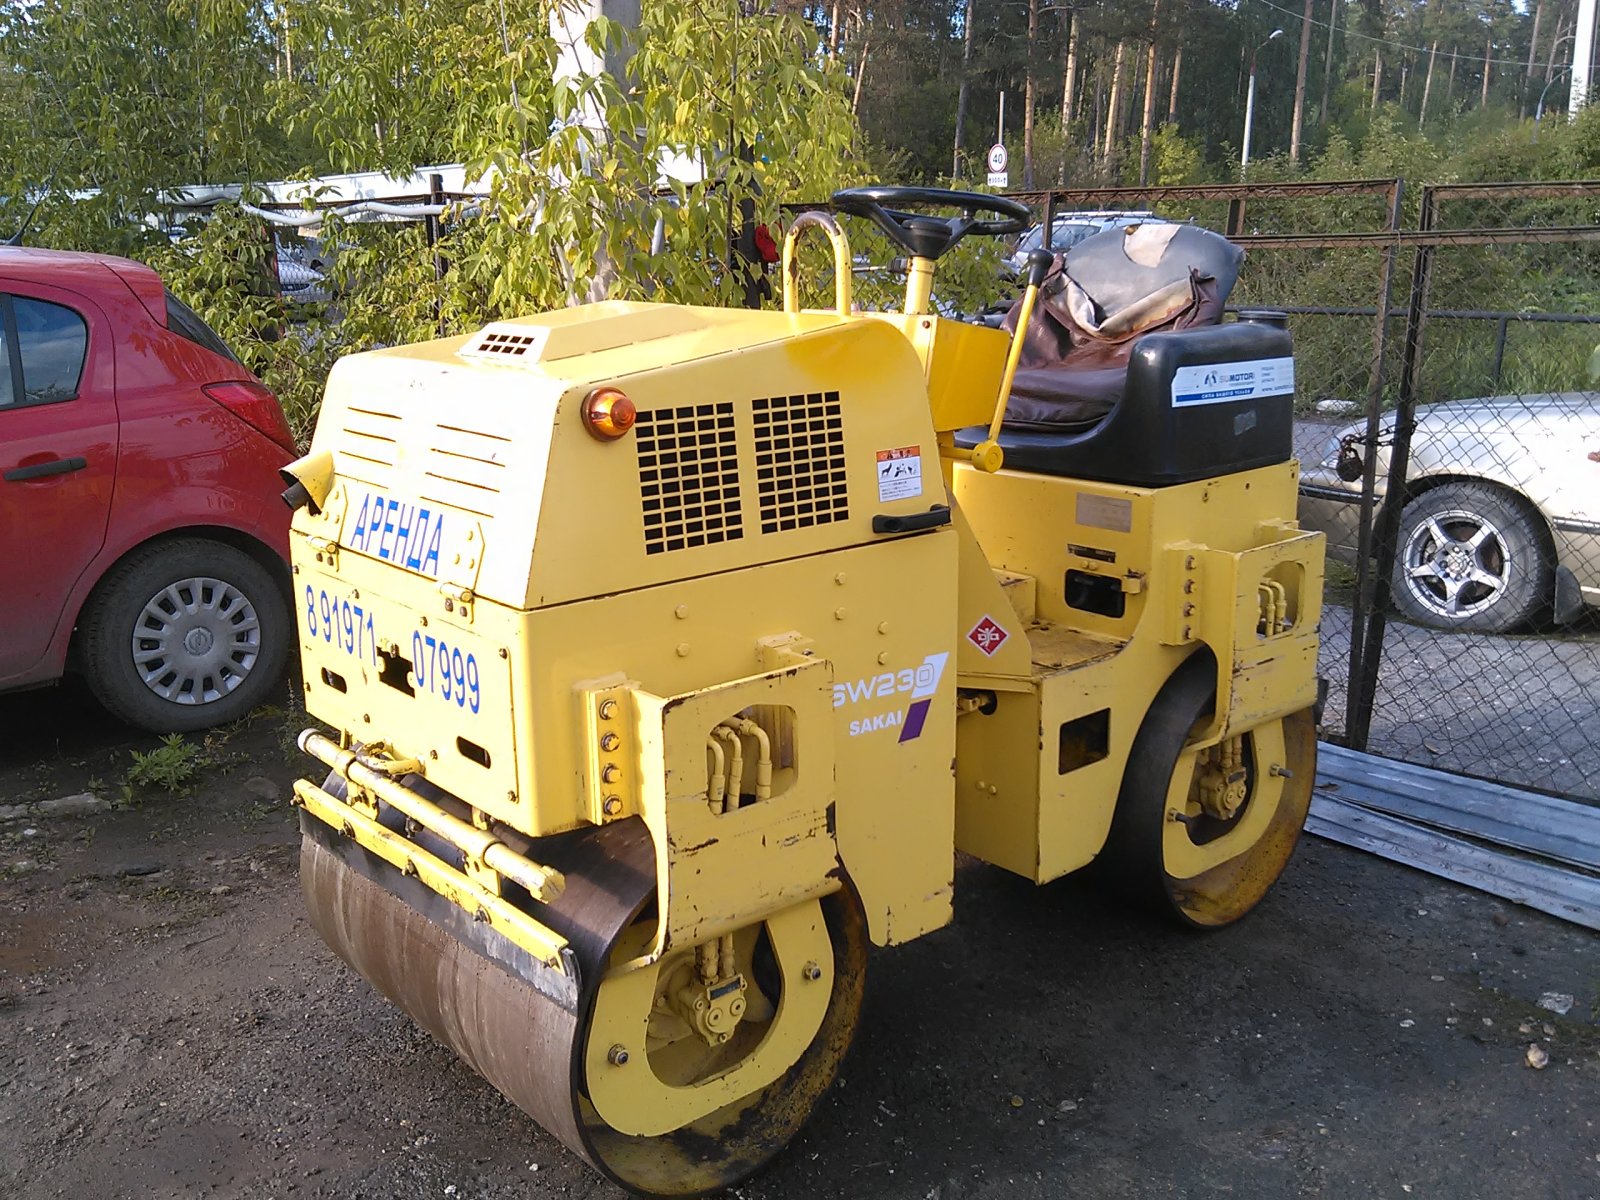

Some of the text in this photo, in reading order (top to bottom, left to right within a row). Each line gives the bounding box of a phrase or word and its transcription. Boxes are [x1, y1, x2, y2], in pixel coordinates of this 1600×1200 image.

[993, 154, 1003, 164] 40
[350, 493, 443, 576] АРЕНДА
[413, 630, 480, 714] 07999
[833, 662, 935, 707] SW230
[849, 710, 902, 736] SAKAI
